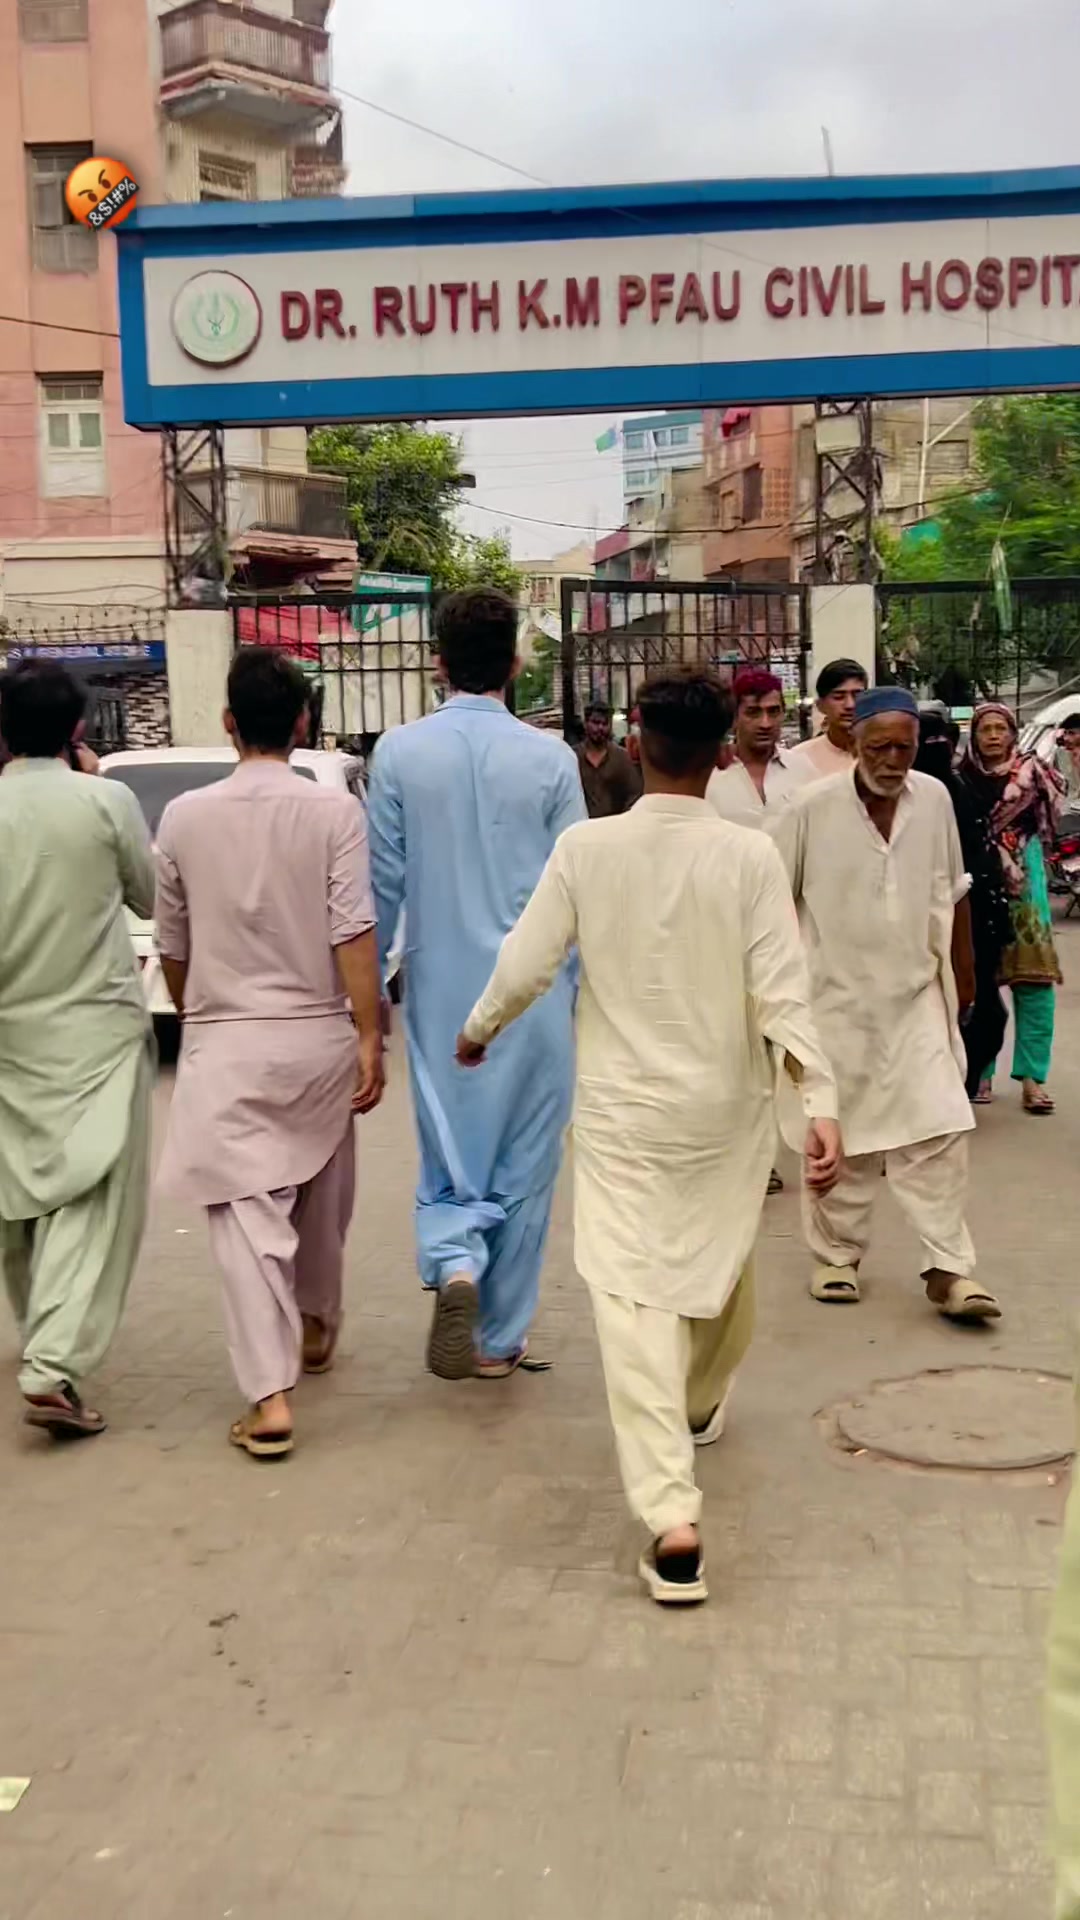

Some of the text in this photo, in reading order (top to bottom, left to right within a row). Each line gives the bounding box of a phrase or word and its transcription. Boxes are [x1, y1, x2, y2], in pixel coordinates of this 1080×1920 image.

[280, 254, 1080, 341] DR. RUTH K.M PFAU CIVIL HOSPIT
